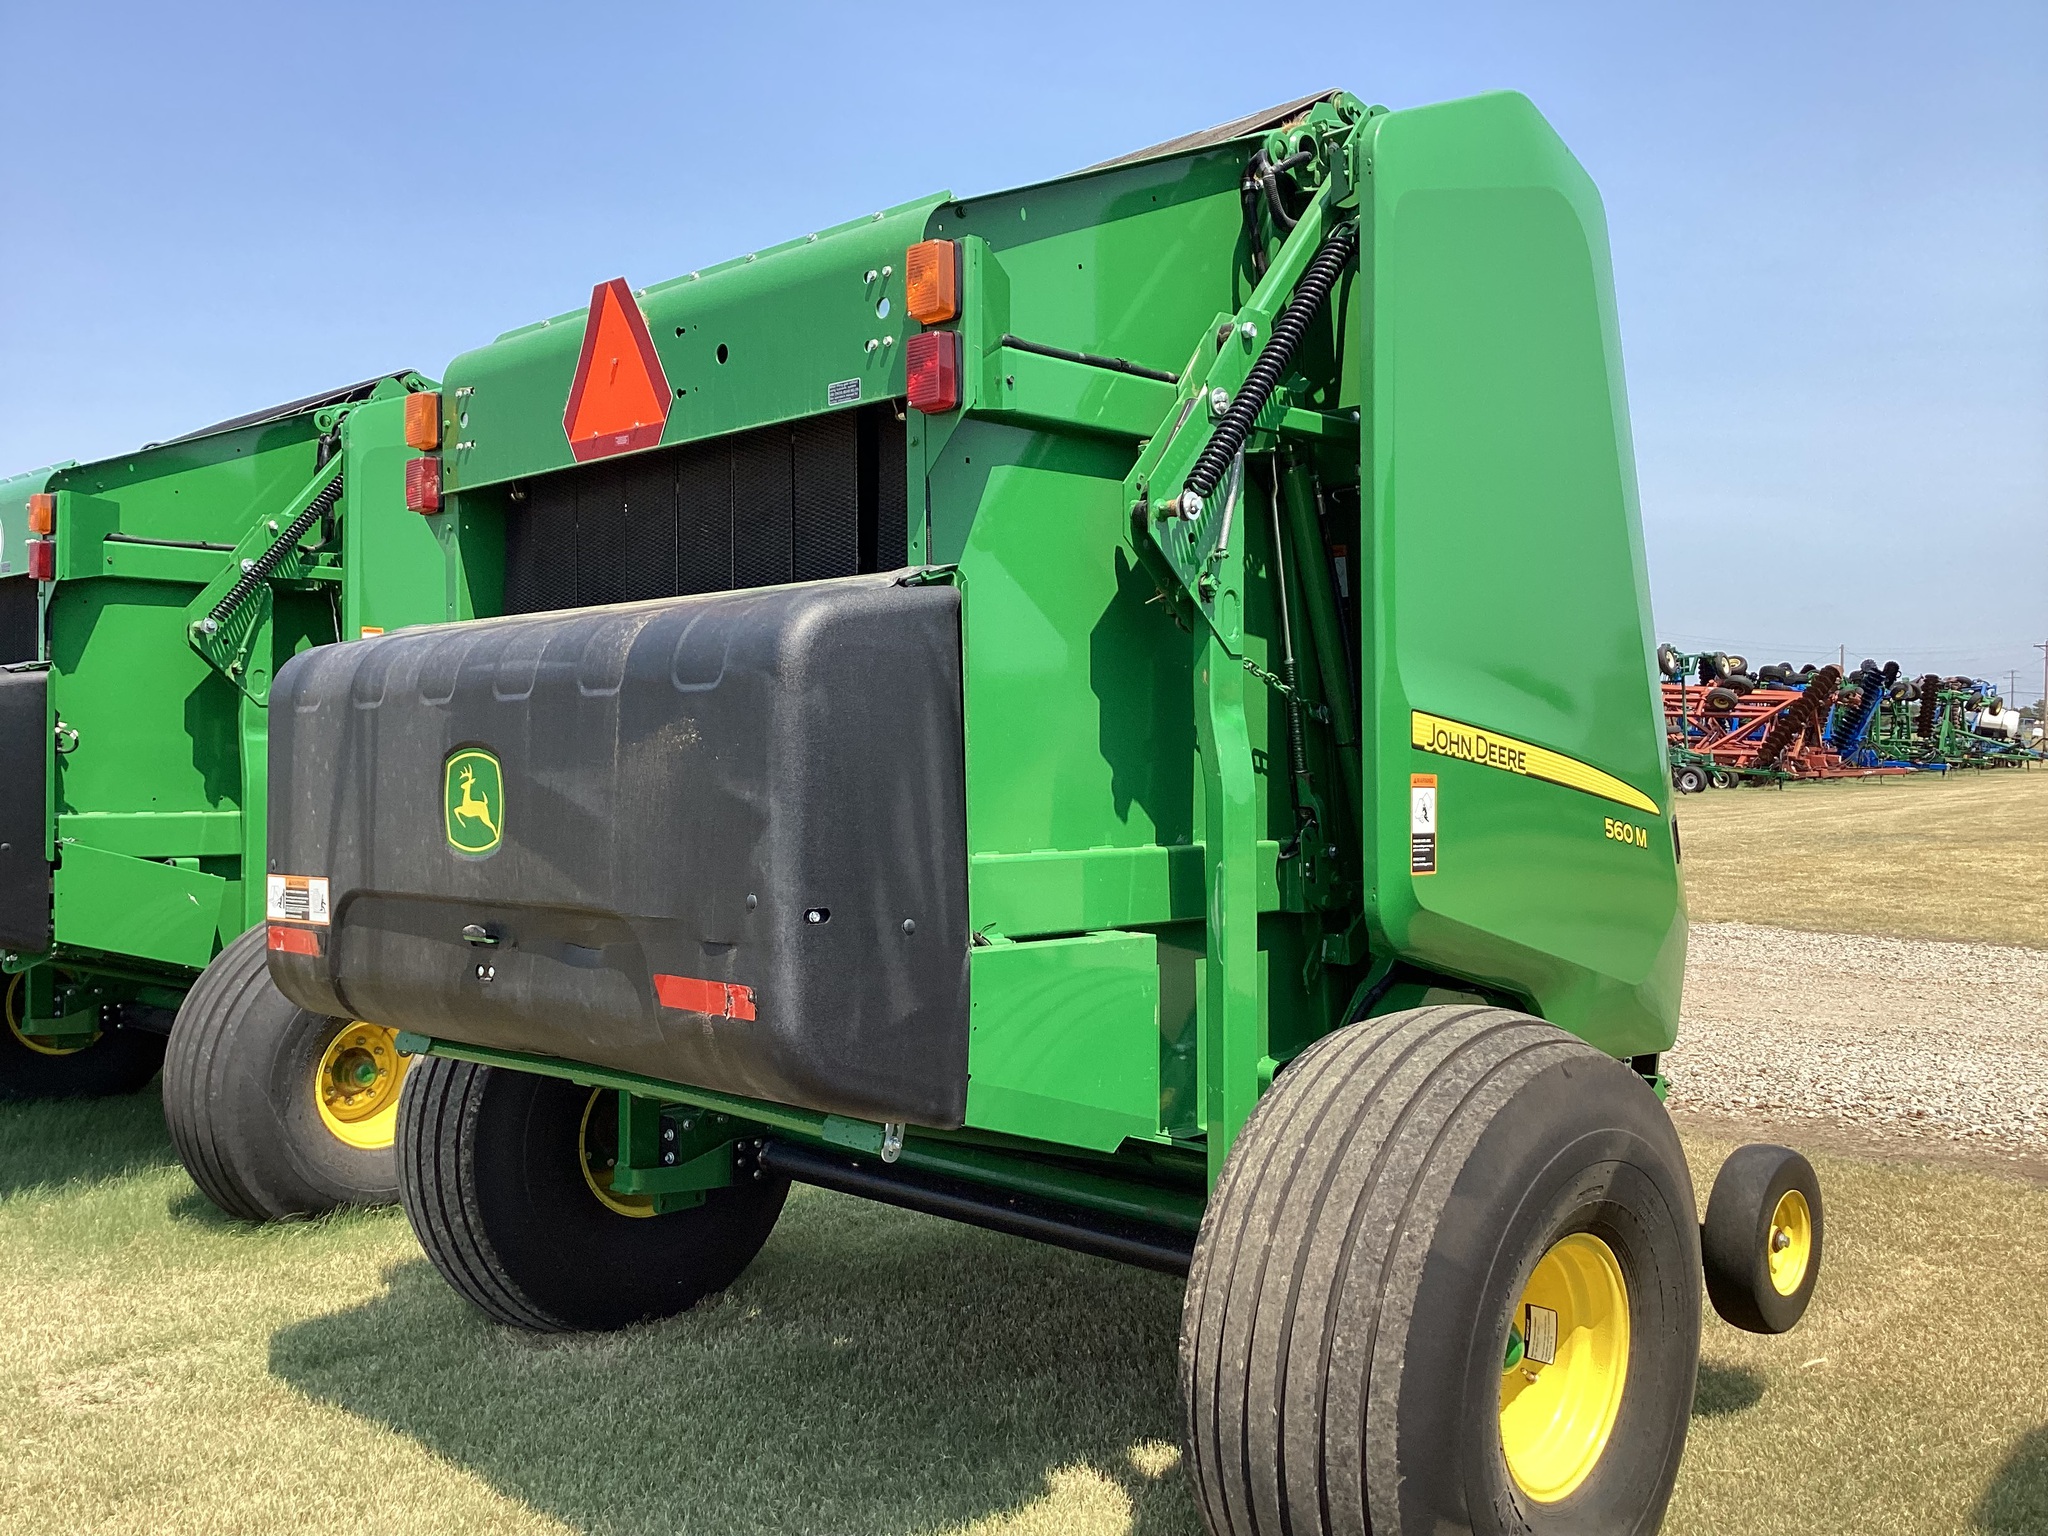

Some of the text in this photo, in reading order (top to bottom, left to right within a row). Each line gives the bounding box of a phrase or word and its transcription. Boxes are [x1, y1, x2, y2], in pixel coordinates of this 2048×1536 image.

[1427, 723, 1526, 771] JOHN DEERE
[1604, 816, 1648, 849] 560 M
